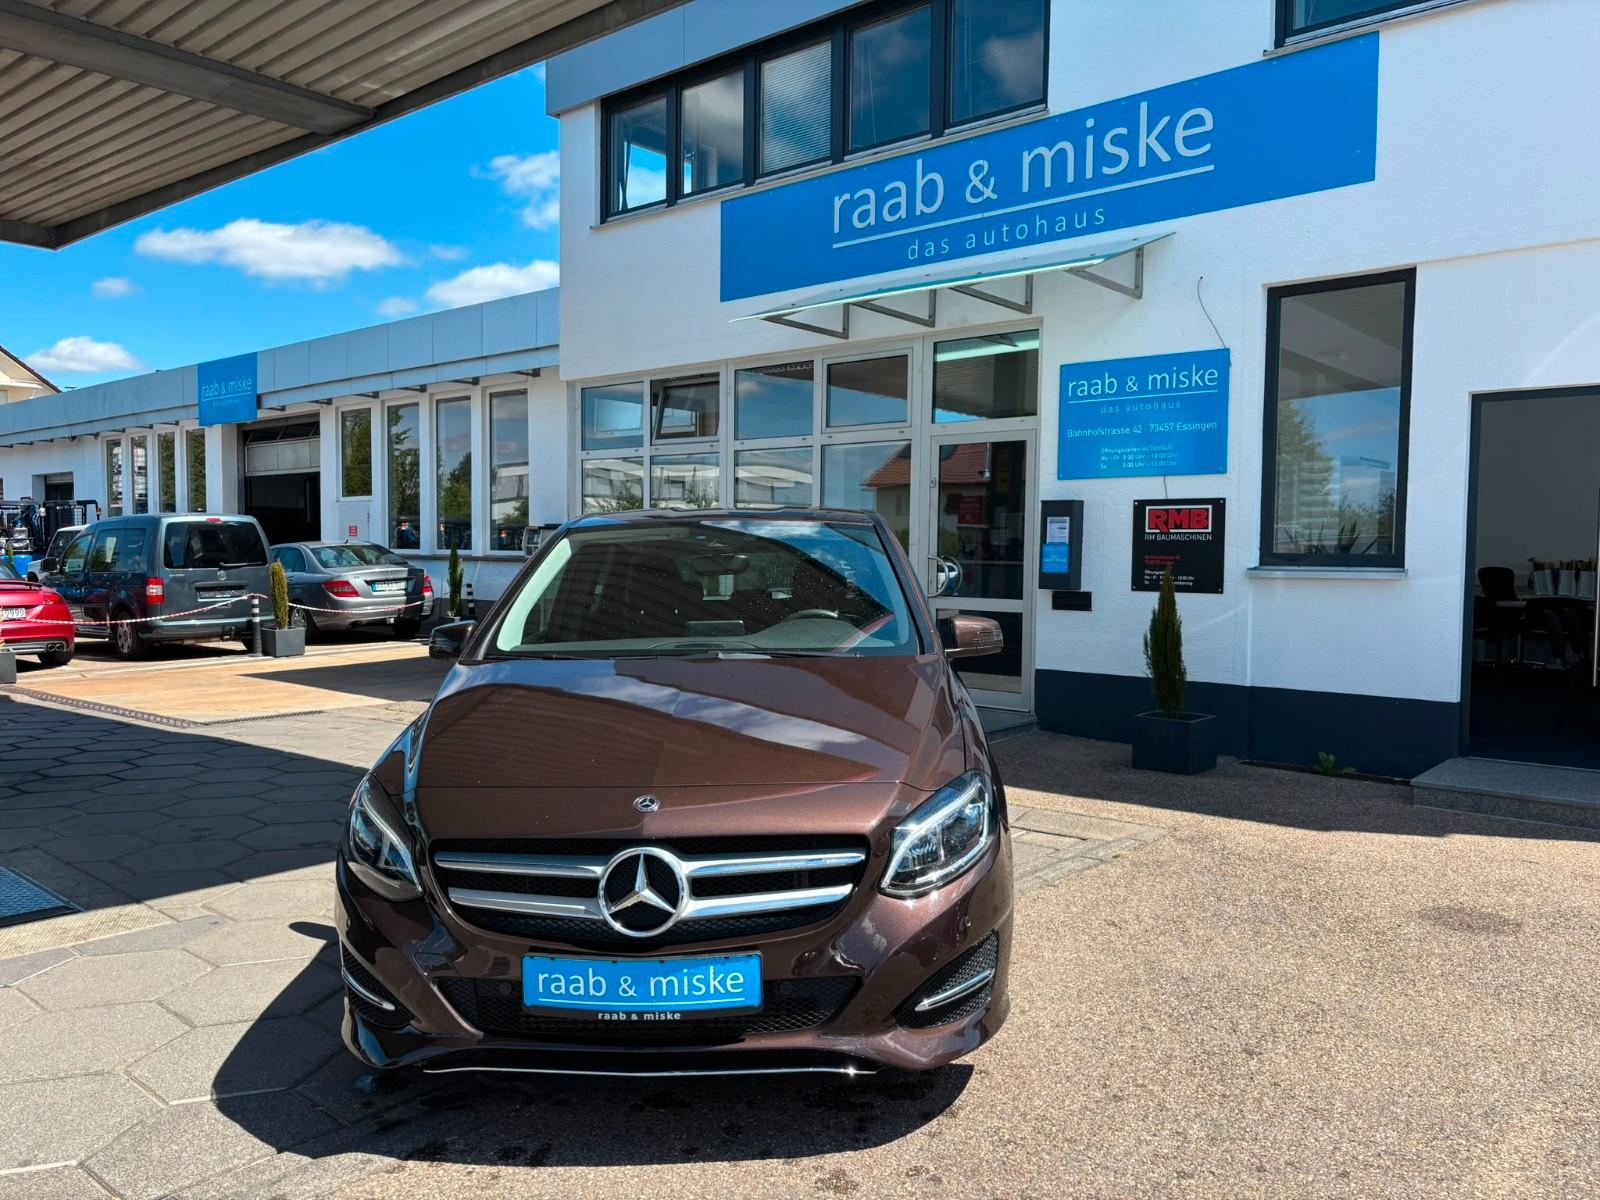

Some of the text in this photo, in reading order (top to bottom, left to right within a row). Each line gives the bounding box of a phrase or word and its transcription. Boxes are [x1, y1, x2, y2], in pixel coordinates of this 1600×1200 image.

[833, 101, 1214, 234] raab & miske
[908, 205, 1106, 260] das autohaus
[202, 378, 219, 399] raab
[229, 376, 252, 393] miske
[1068, 364, 1219, 398] raab & miske
[1101, 400, 1181, 414] das autohaus
[1067, 420, 1218, 438] Bahnhofstrasse 42 73457 Essingen
[1149, 508, 1208, 533] RMB
[1145, 533, 1212, 541] RM BAUMASCHINEN
[538, 965, 744, 997] raab & miske
[598, 1011, 627, 1020] raab
[643, 1011, 681, 1020] miske
